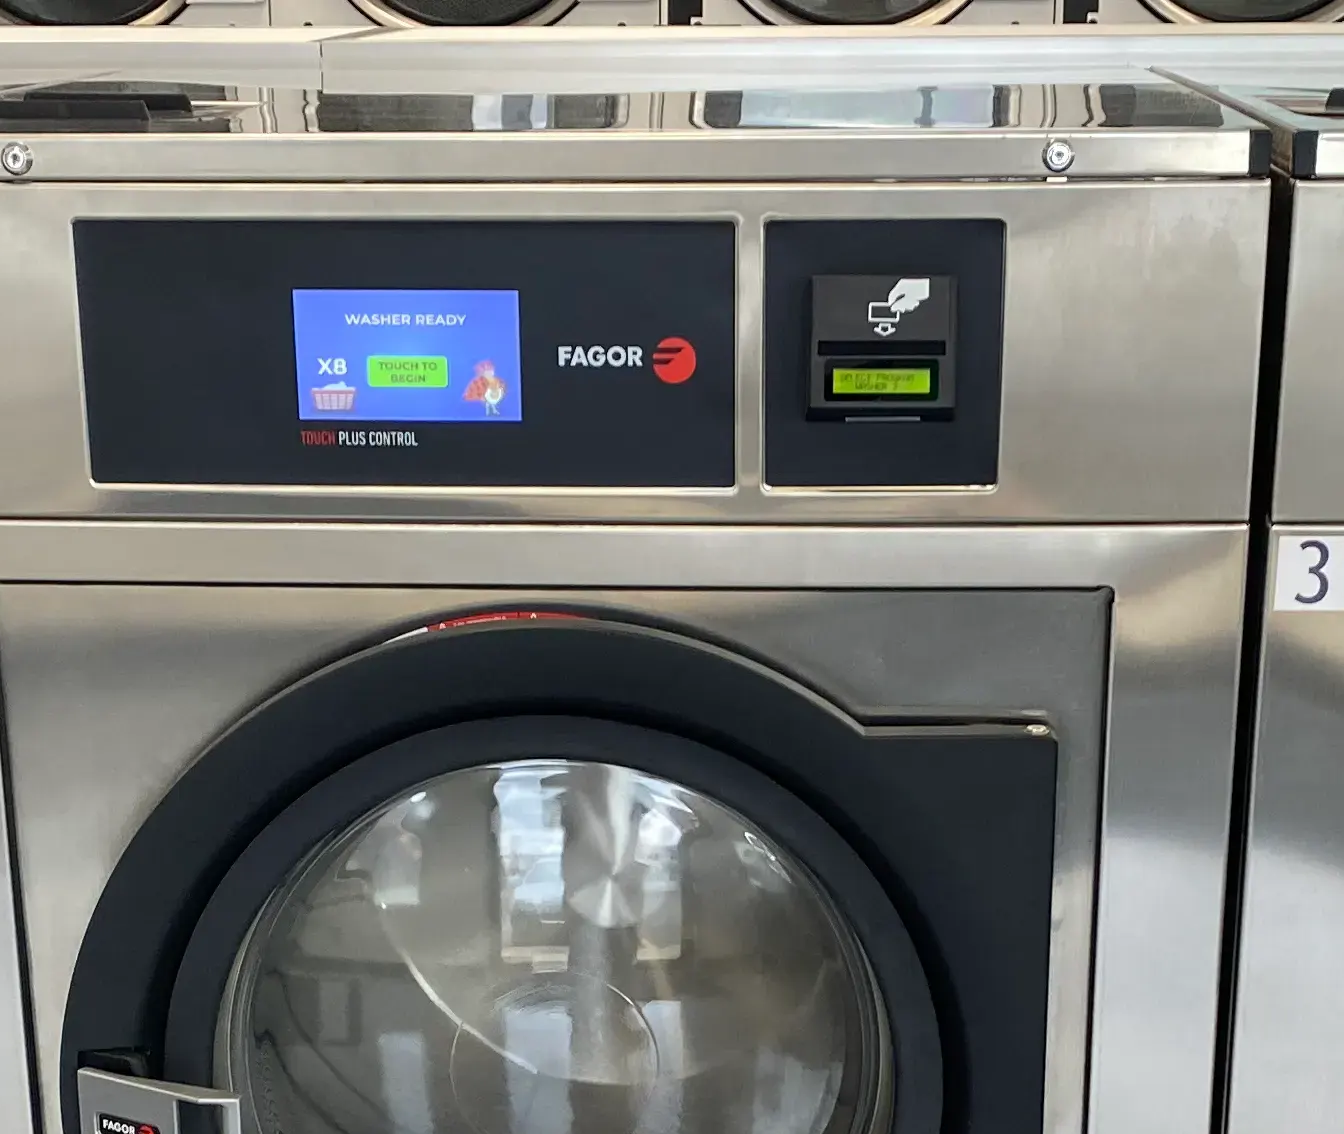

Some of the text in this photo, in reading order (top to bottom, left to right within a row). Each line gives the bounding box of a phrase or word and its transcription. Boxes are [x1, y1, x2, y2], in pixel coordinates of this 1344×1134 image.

[344, 313, 467, 327] WASHER READY
[557, 345, 643, 367] FAGOR
[317, 358, 348, 376] X8
[378, 361, 438, 372] TOUCH TO
[390, 374, 427, 384] BEGIN
[300, 431, 418, 446] TOUCH PLUS CONTROL
[1295, 540, 1329, 603] 3
